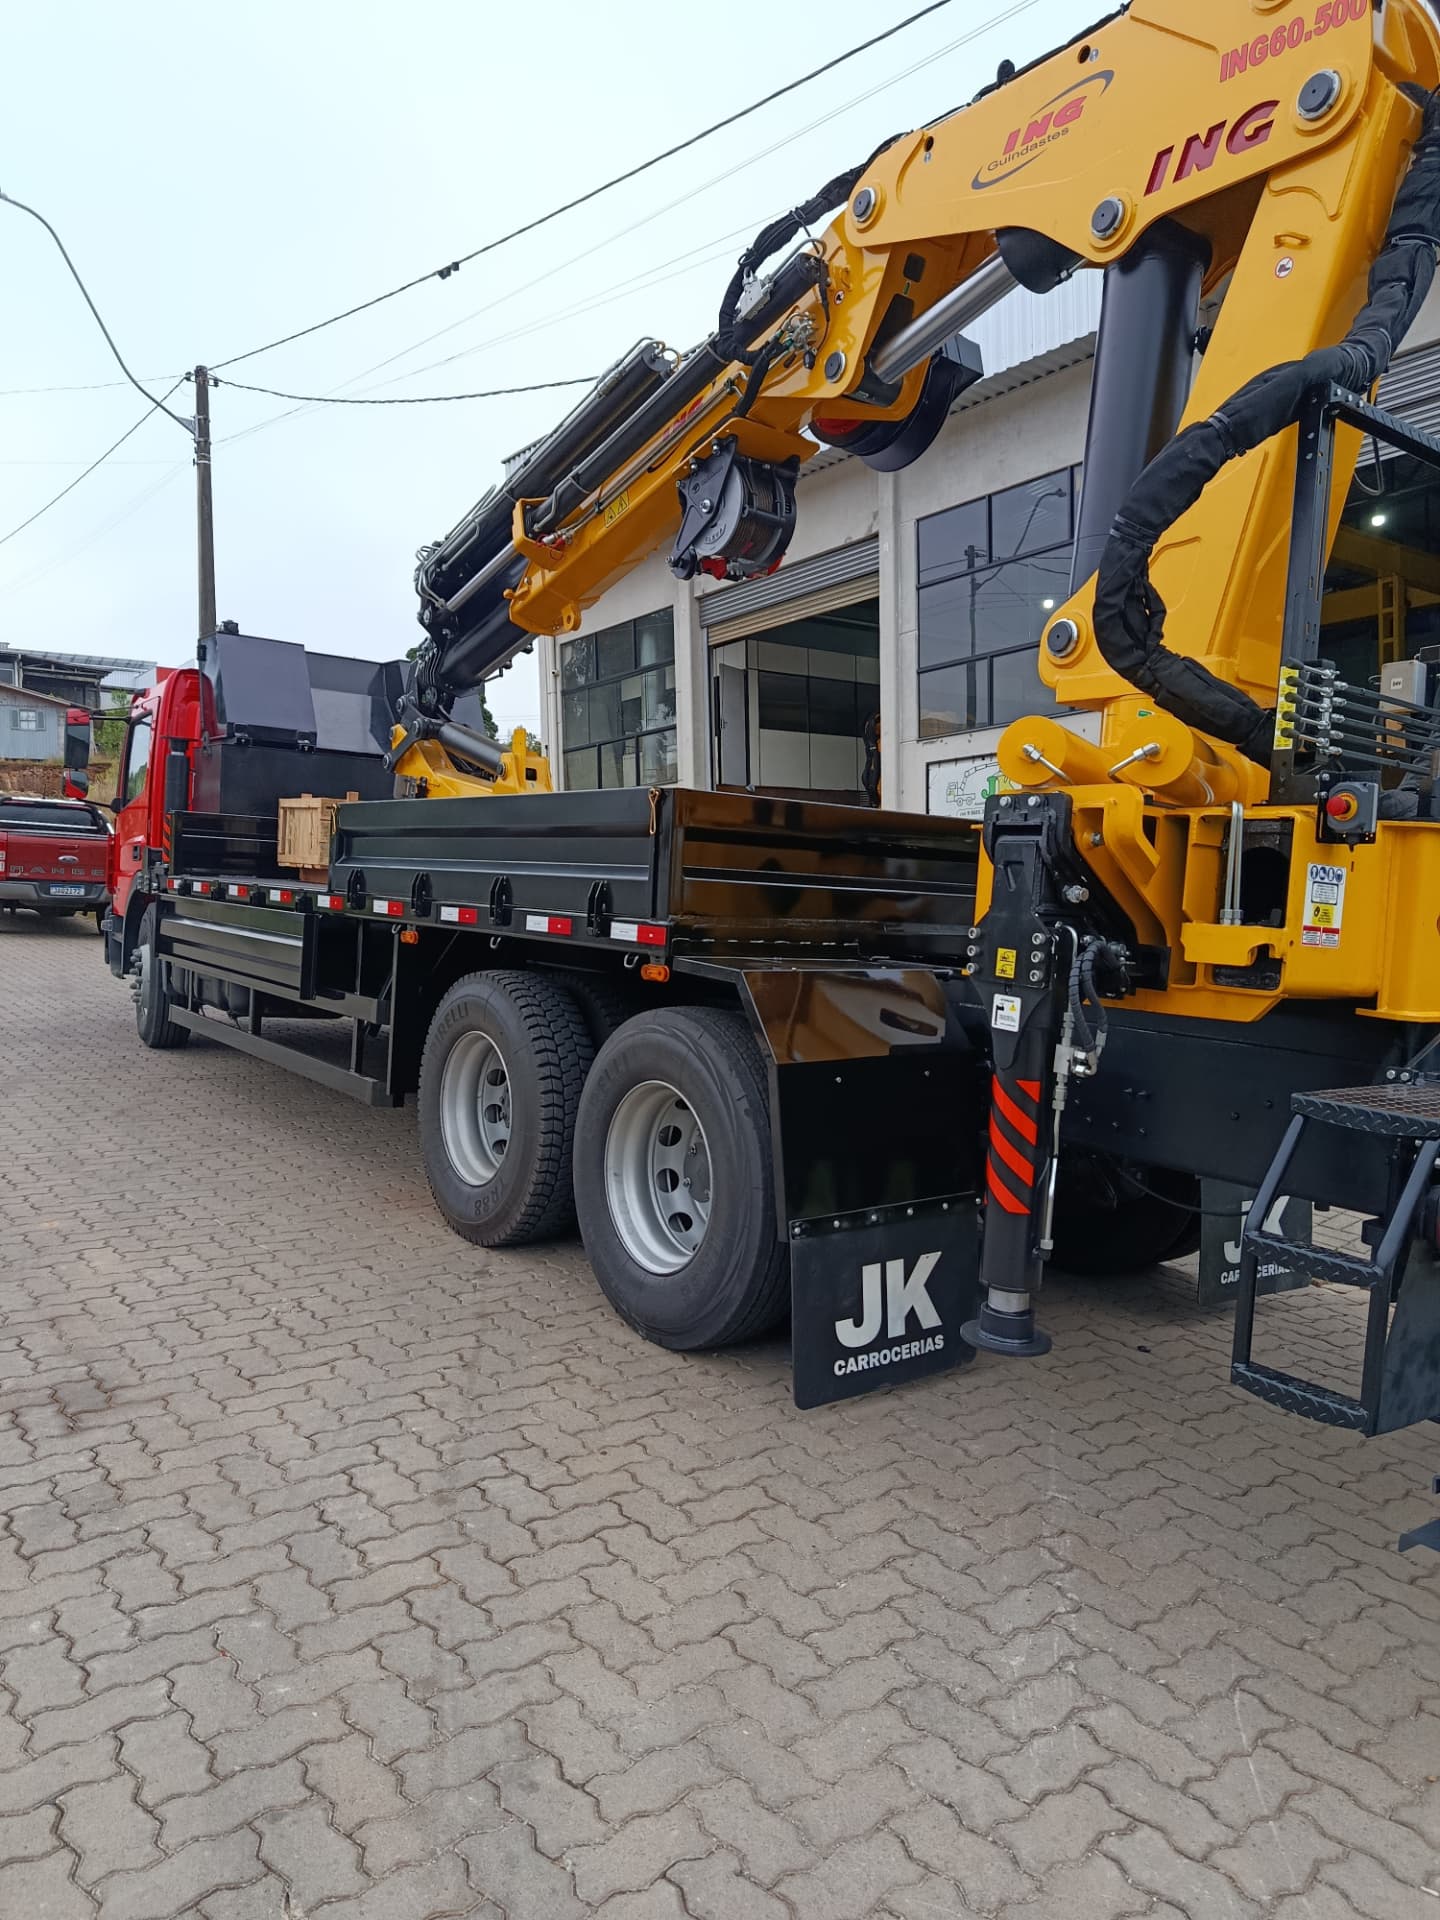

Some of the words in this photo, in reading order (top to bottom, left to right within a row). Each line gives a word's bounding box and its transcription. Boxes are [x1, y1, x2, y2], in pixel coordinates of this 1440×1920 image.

[1220, 0, 1367, 82] ING60.500
[987, 127, 1069, 171] Guindastes
[1003, 96, 1087, 155] ING
[1144, 100, 1280, 197] ING
[835, 1251, 942, 1348] JK
[834, 1334, 944, 1376] CARROCERIAS
